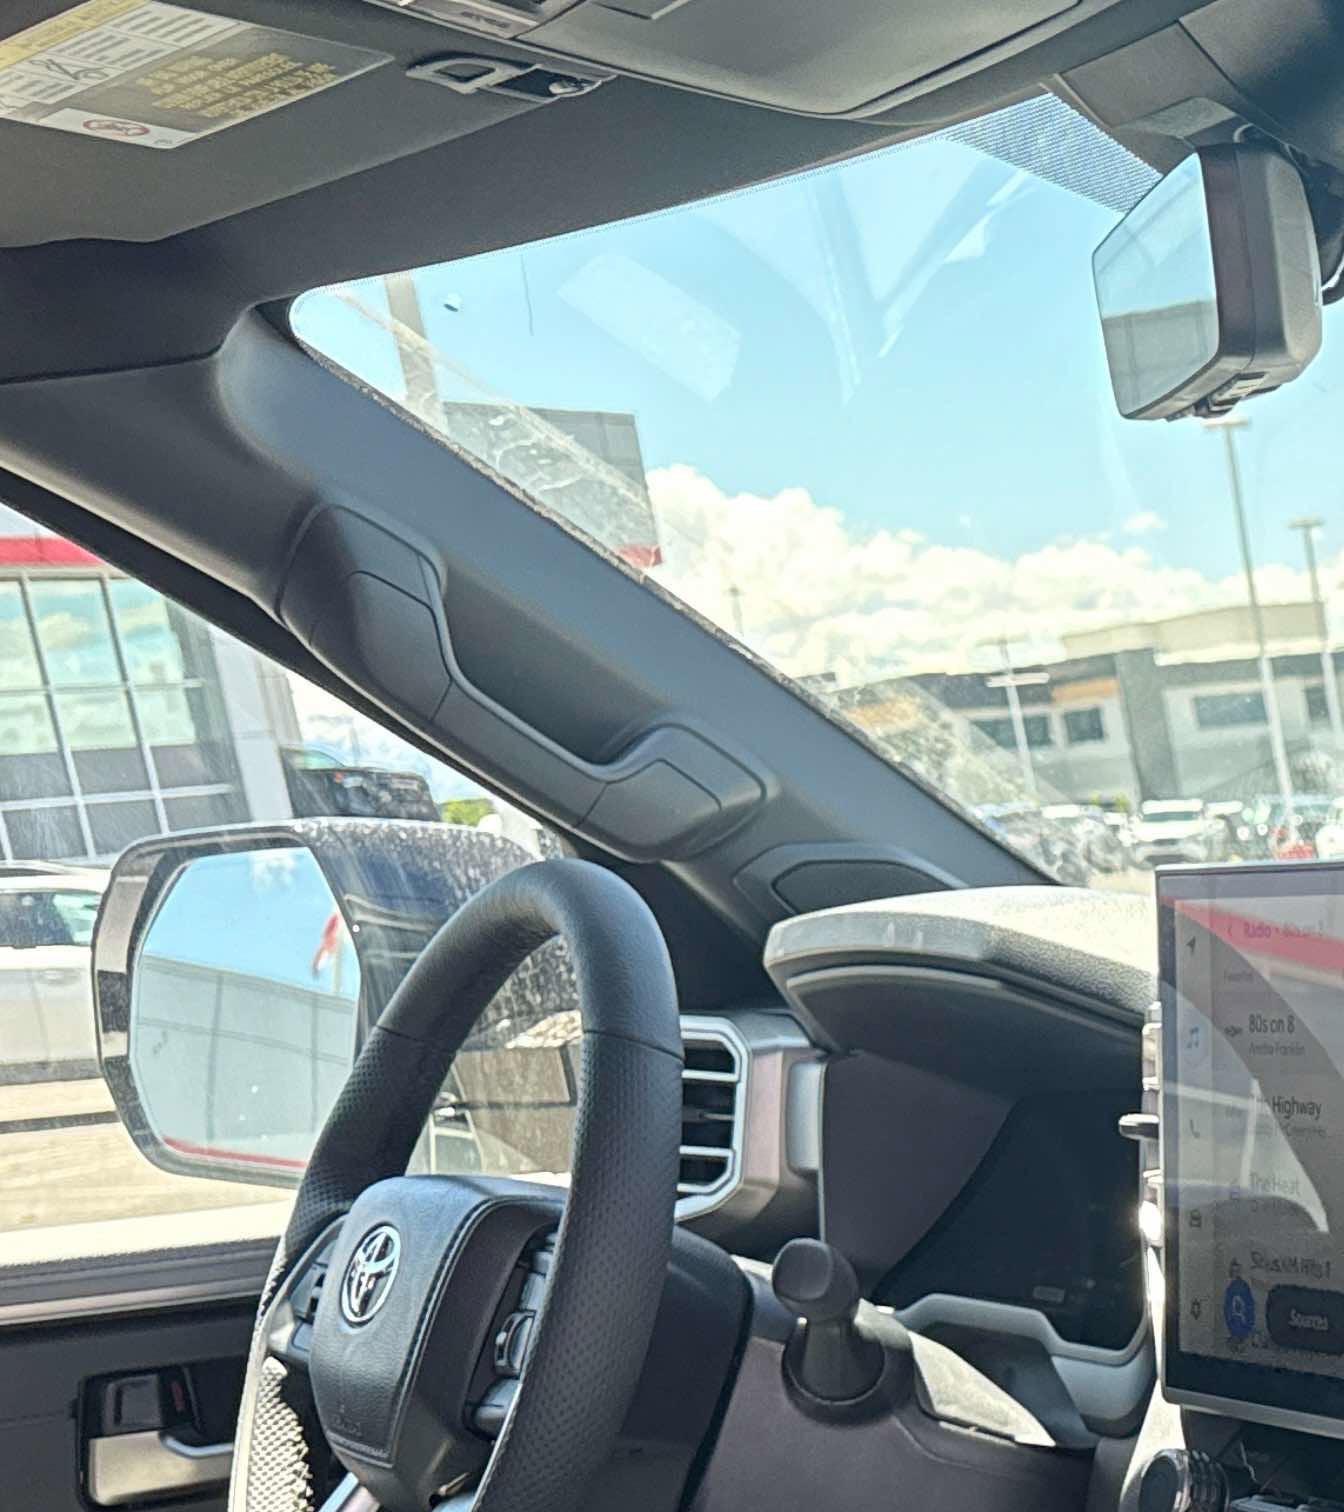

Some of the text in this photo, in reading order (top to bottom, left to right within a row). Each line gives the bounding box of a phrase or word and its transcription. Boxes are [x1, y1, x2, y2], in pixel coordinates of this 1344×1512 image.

[1249, 1015, 1296, 1033] 80s on 8
[1272, 1095, 1322, 1121] Highway
